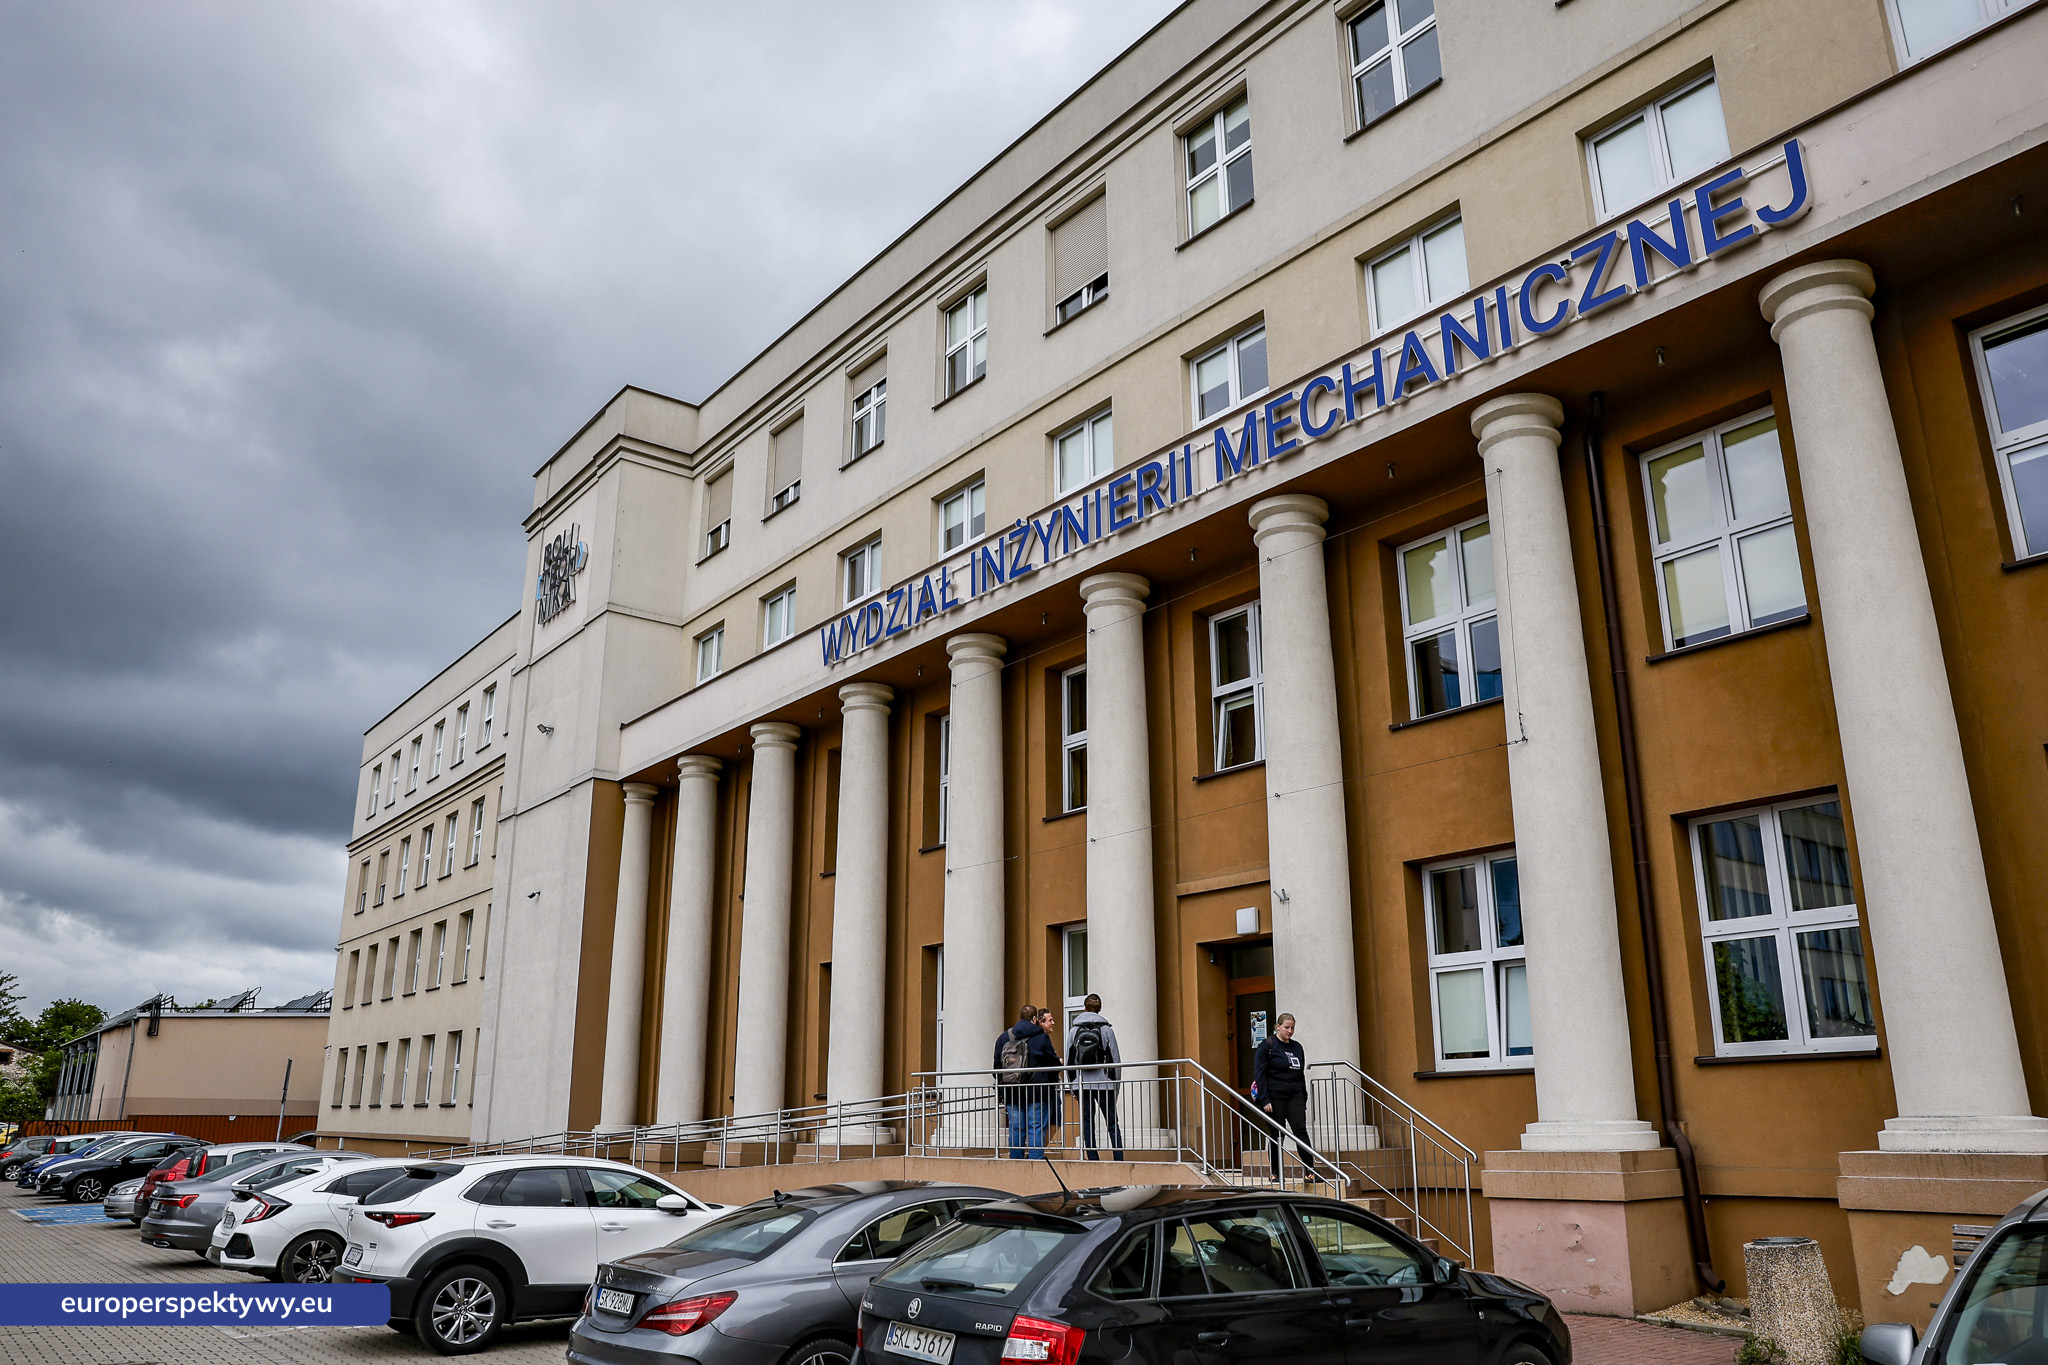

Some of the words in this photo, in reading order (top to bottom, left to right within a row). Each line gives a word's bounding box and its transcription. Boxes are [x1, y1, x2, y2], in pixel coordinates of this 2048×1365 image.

[820, 567, 959, 665] WYDZIAŁ
[970, 443, 1194, 597] INŻYNIERII
[1214, 138, 1808, 483] MECHANICZNEJ
[600, 1290, 612, 1308] SK
[975, 1322, 1003, 1332] RAPID
[892, 1326, 911, 1349] SKL
[914, 1331, 952, 1357] 51617
